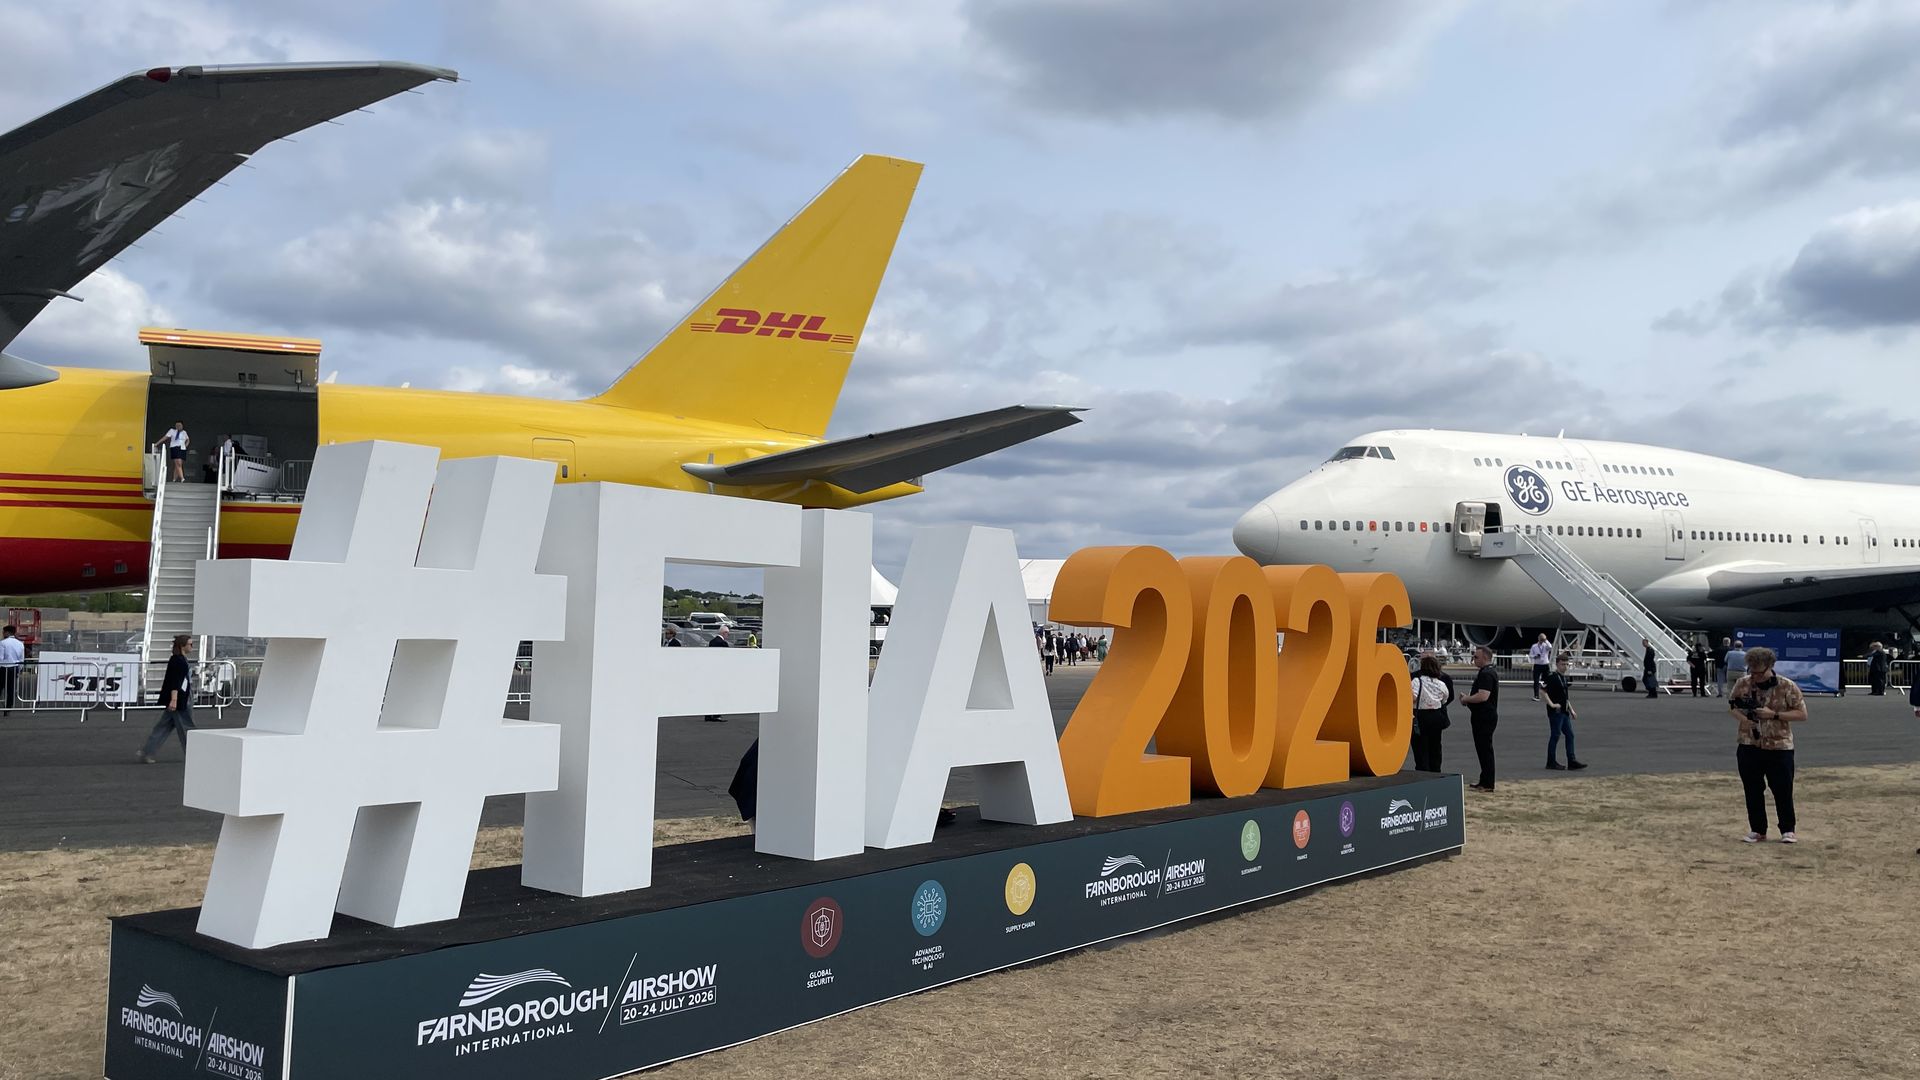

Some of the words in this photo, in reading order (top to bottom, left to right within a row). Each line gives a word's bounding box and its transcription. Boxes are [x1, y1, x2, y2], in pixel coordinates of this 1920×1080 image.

[714, 308, 833, 342] DHL
[1561, 480, 1592, 502] GE
[1593, 482, 1690, 511] Aerospace
[1787, 632, 1807, 640] Flying
[64, 676, 123, 692] STS
[1380, 811, 1422, 829] FARNBOROUGH
[1425, 806, 1448, 820] AIRSHOW
[1165, 858, 1205, 881] AIRSHOW
[1085, 869, 1160, 899] FARNBOROUGH
[1166, 881, 1180, 892] 20-24
[1181, 877, 1192, 888] JULY
[1193, 875, 1205, 885] 2026
[1100, 890, 1147, 907] INTERNATIONAL
[1005, 924, 1021, 934] SUPPLY
[1021, 921, 1036, 930] CHAIN
[911, 952, 945, 966] TECHNOLOGY
[915, 945, 942, 957] ADVANCED
[621, 964, 718, 1005] AIRSHOW
[806, 976, 835, 989] SECURITY
[809, 968, 832, 980] GLOBAL
[417, 986, 609, 1046] FARNBOROUGH
[623, 1004, 657, 1021] 20-24
[659, 998, 685, 1014] JULY
[687, 990, 714, 1007] 2026
[121, 1007, 202, 1048] FARNBOROUGH
[134, 1035, 184, 1059] INTERNATIONAL
[207, 1033, 265, 1067] AIRSHOW
[455, 1022, 574, 1057] INTERNATIONAL
[208, 1056, 227, 1072] 20-24
[228, 1063, 244, 1077] JULY
[245, 1068, 262, 1080] 2026
